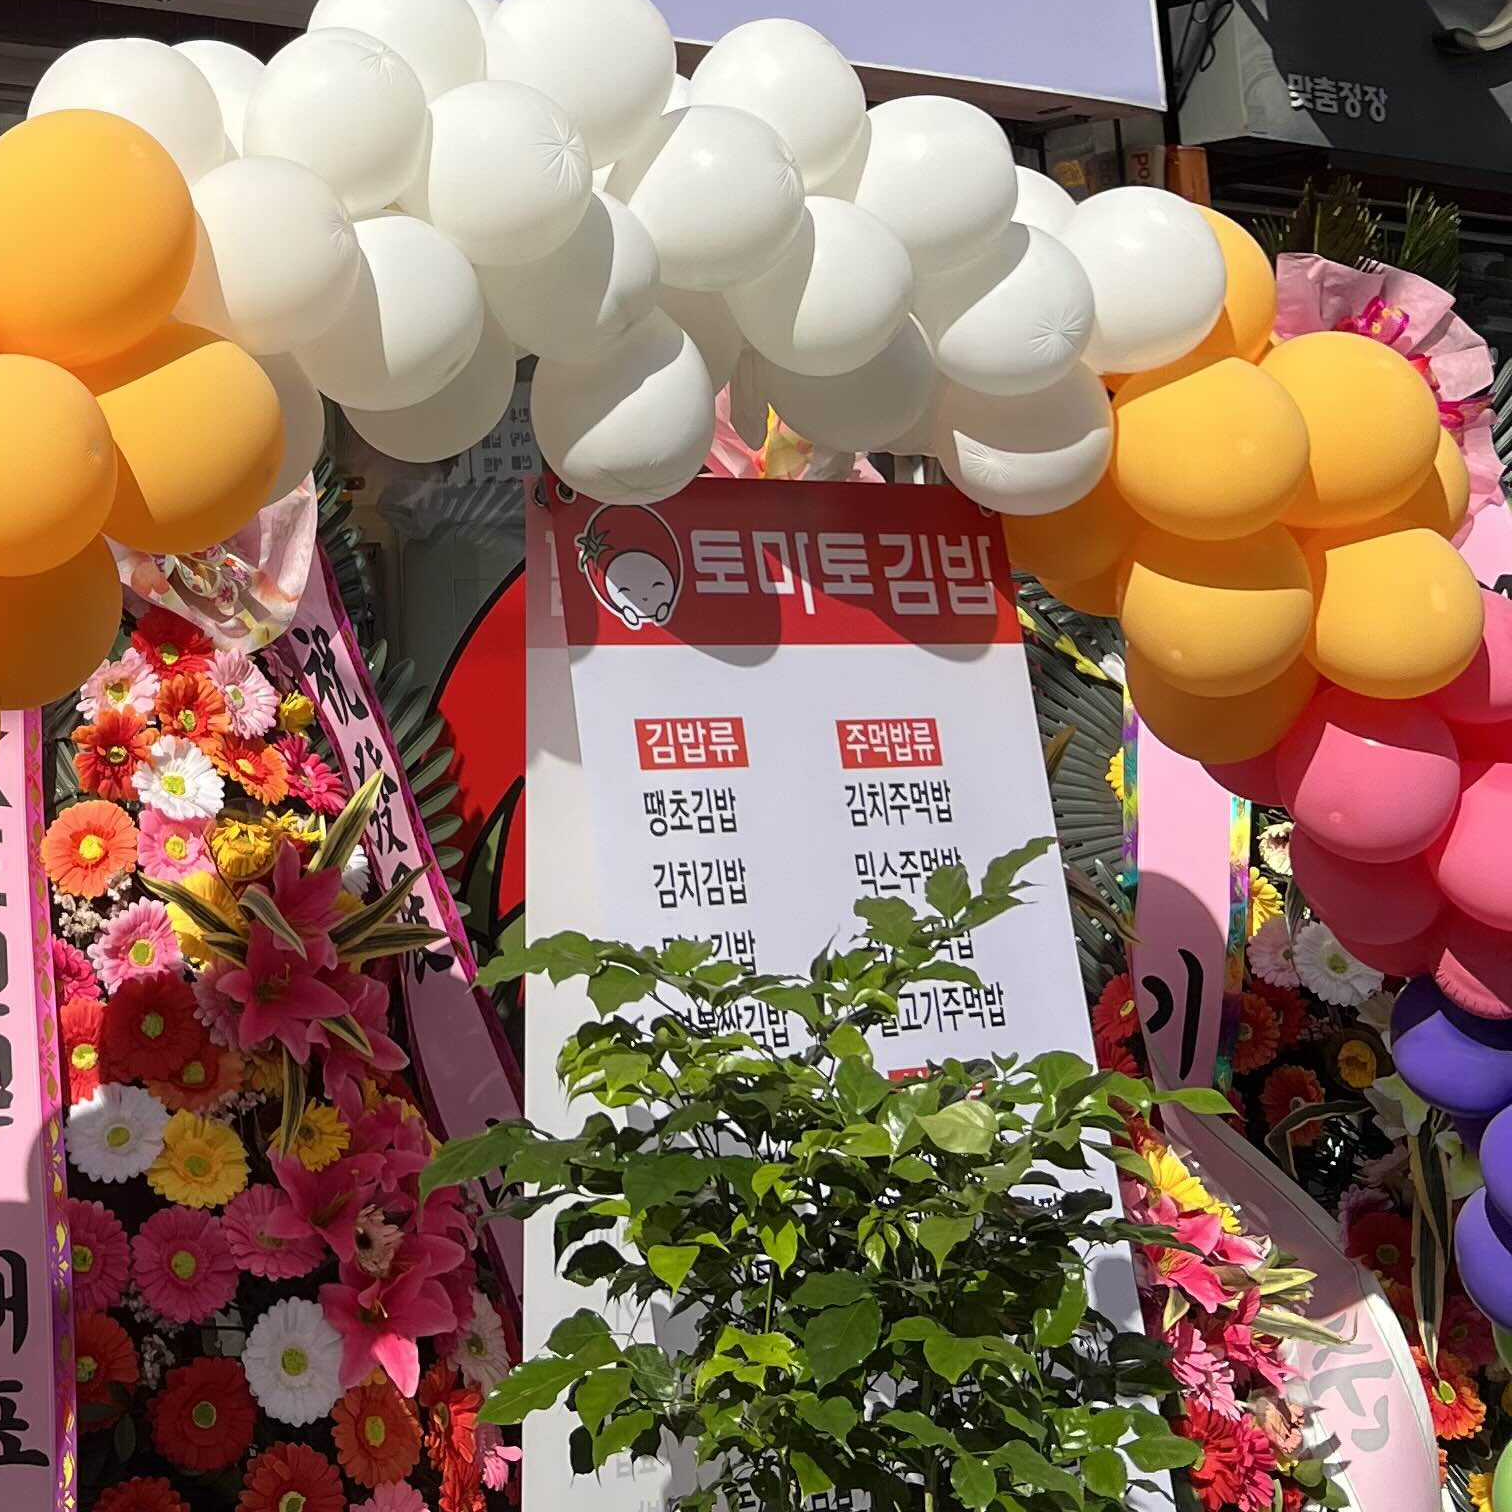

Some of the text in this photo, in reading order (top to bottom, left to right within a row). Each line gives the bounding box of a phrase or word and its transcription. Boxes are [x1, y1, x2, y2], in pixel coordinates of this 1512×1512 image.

[1288, 73, 1388, 123] 맞춤정장
[691, 529, 998, 616] 토마토김밥
[645, 721, 739, 764] 김밥류
[846, 721, 936, 763] 주먹밥류
[643, 787, 738, 837] 땡초김밥
[845, 780, 953, 827] 김치주먹밥
[653, 858, 748, 909] 김치김밥
